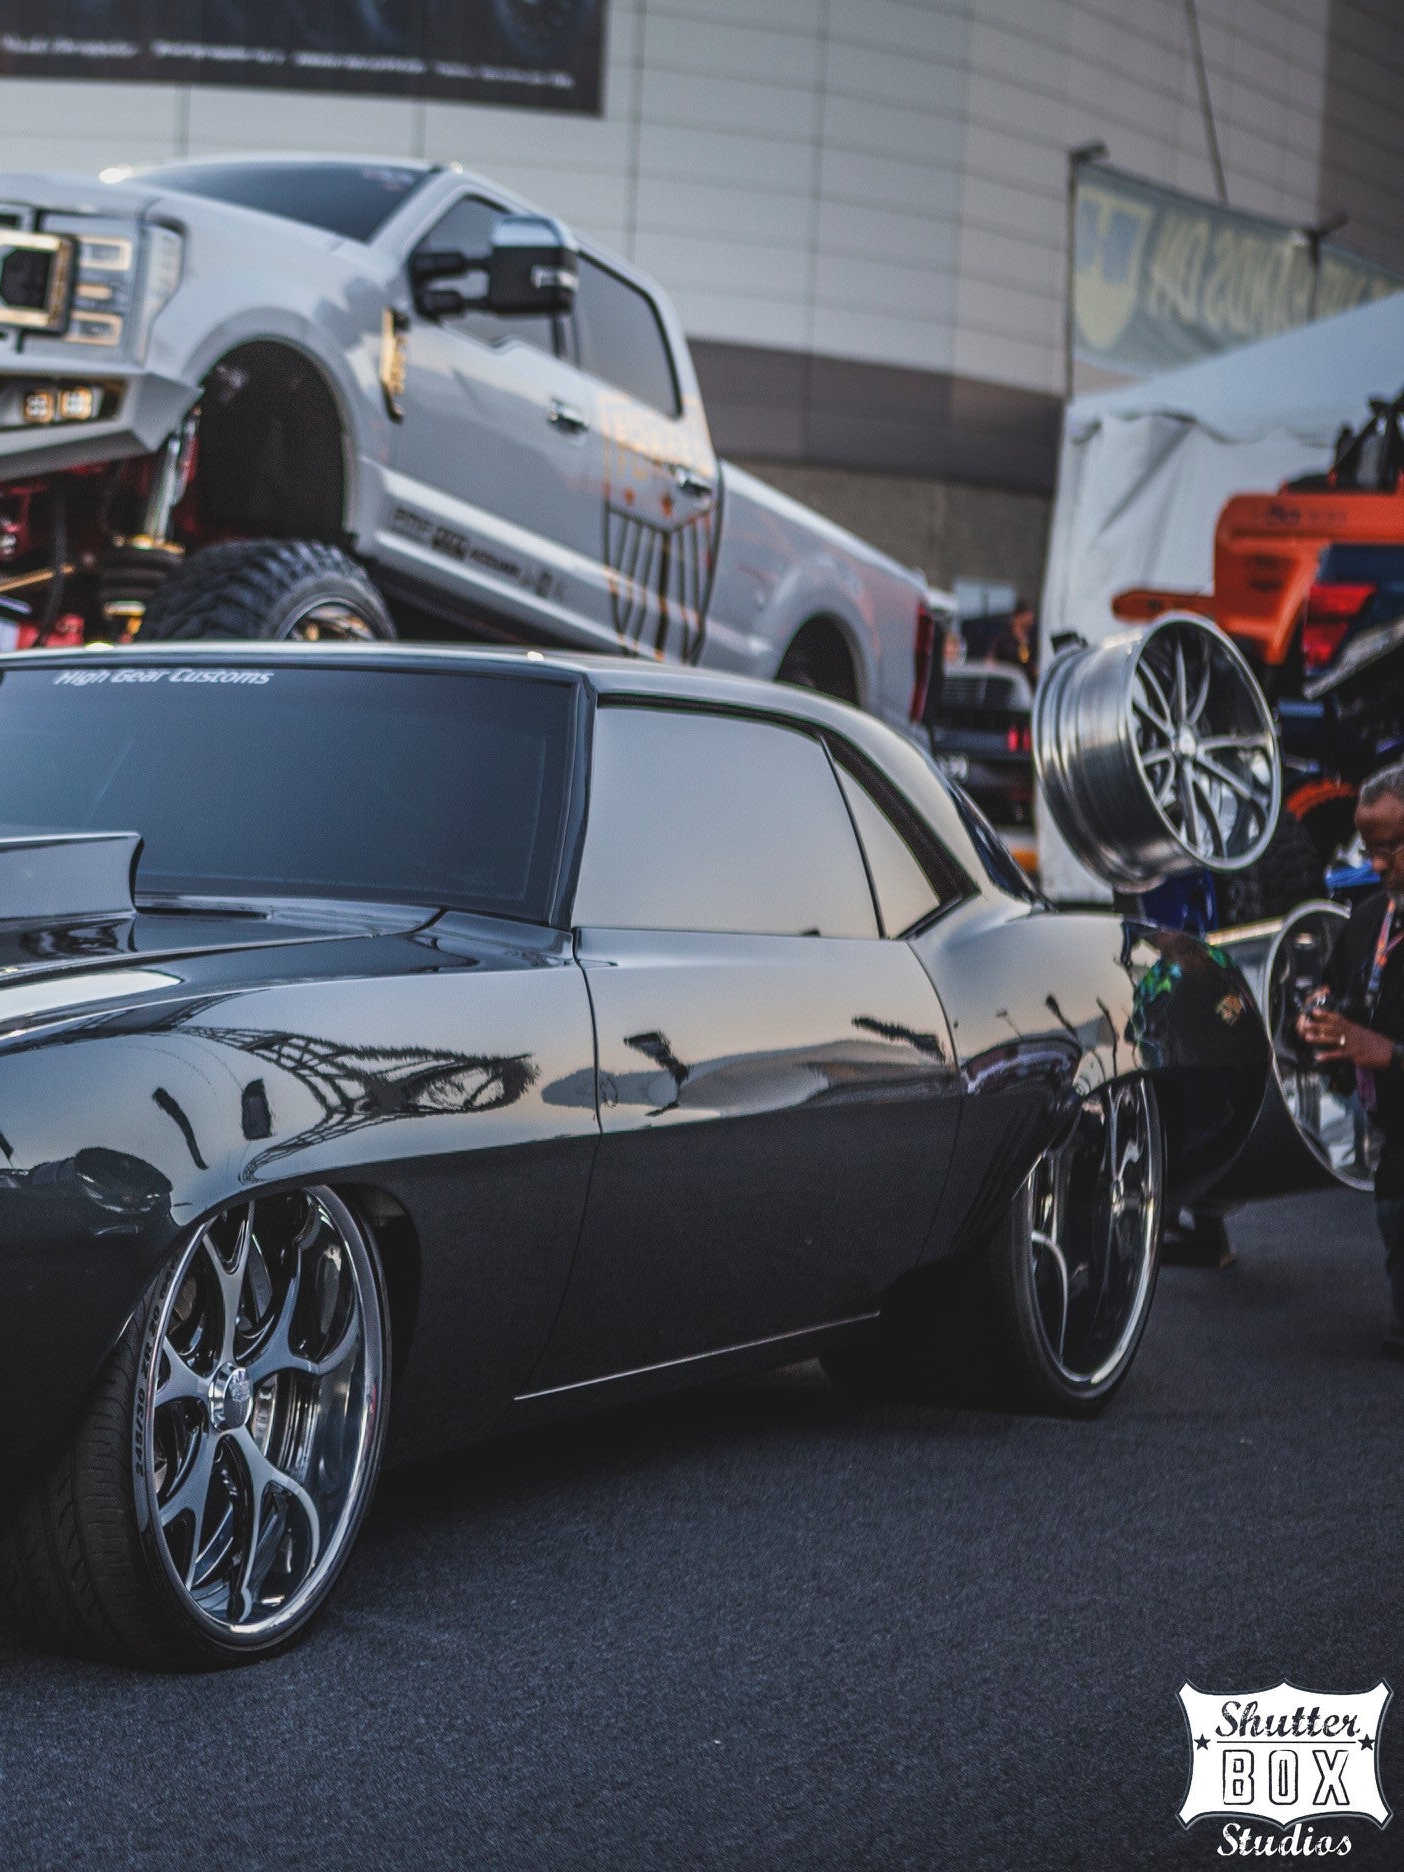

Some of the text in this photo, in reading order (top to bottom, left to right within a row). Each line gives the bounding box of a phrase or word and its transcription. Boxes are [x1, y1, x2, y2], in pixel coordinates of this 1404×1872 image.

[54, 668, 274, 687] High Gear Customs
